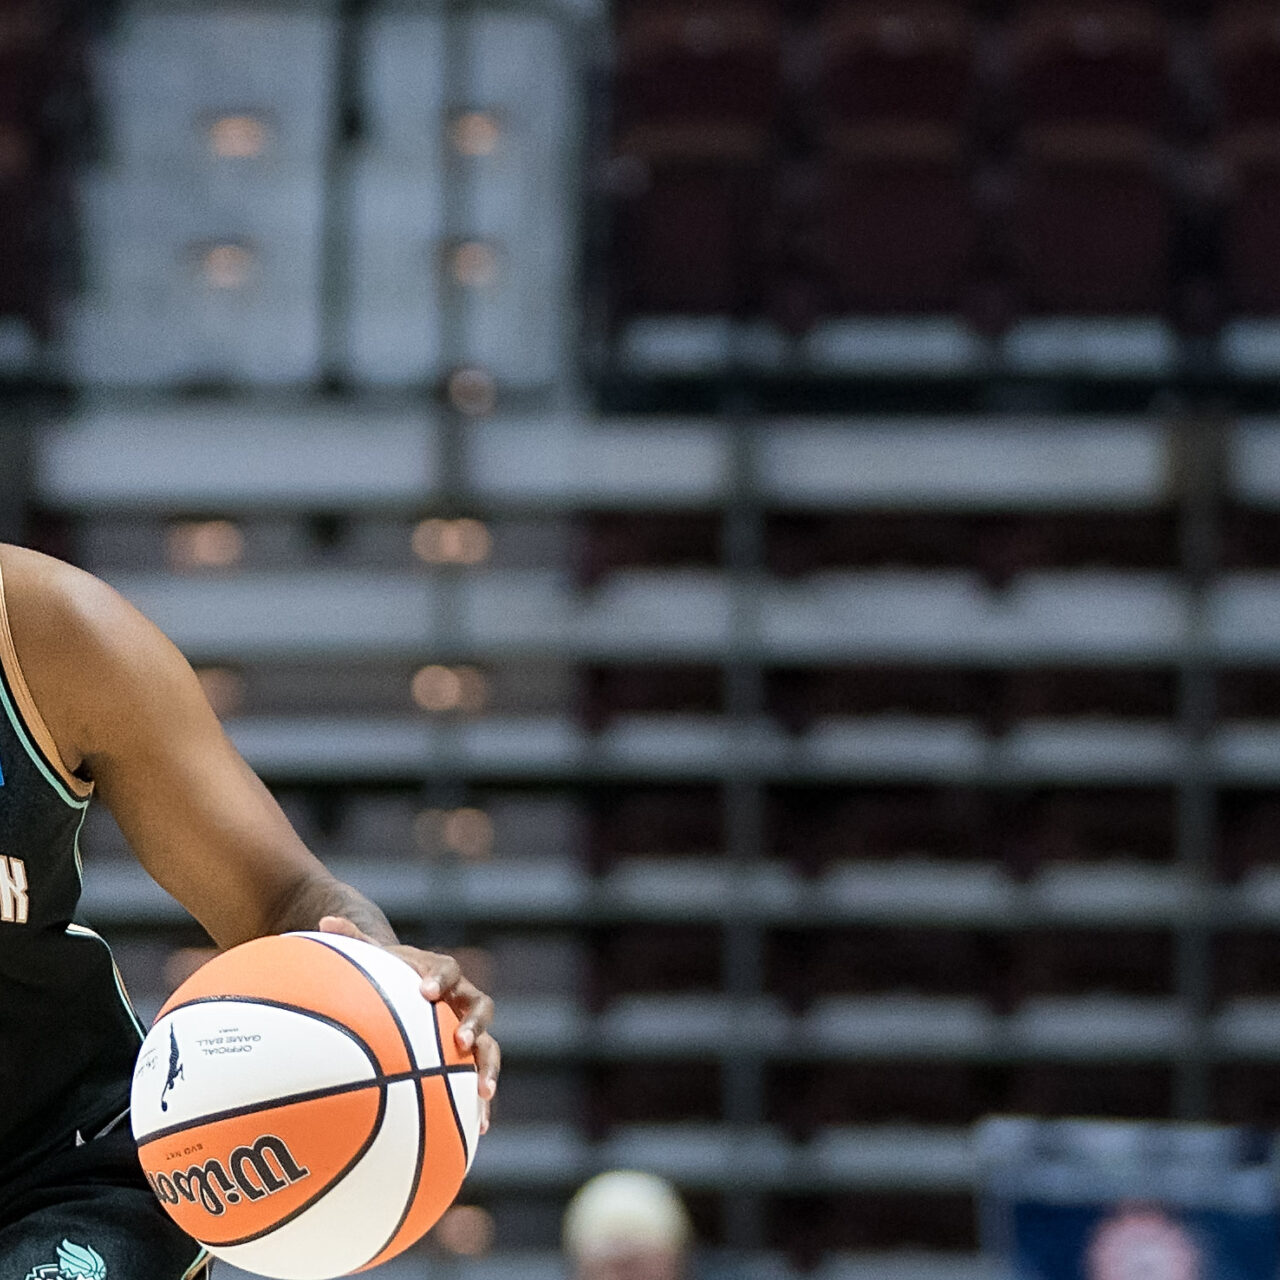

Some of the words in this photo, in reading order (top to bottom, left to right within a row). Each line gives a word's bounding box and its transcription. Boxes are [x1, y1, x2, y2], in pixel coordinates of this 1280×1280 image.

[195, 1036, 224, 1047] BALL
[226, 1034, 262, 1044] GAME
[201, 1044, 253, 1056] OFFICIAL
